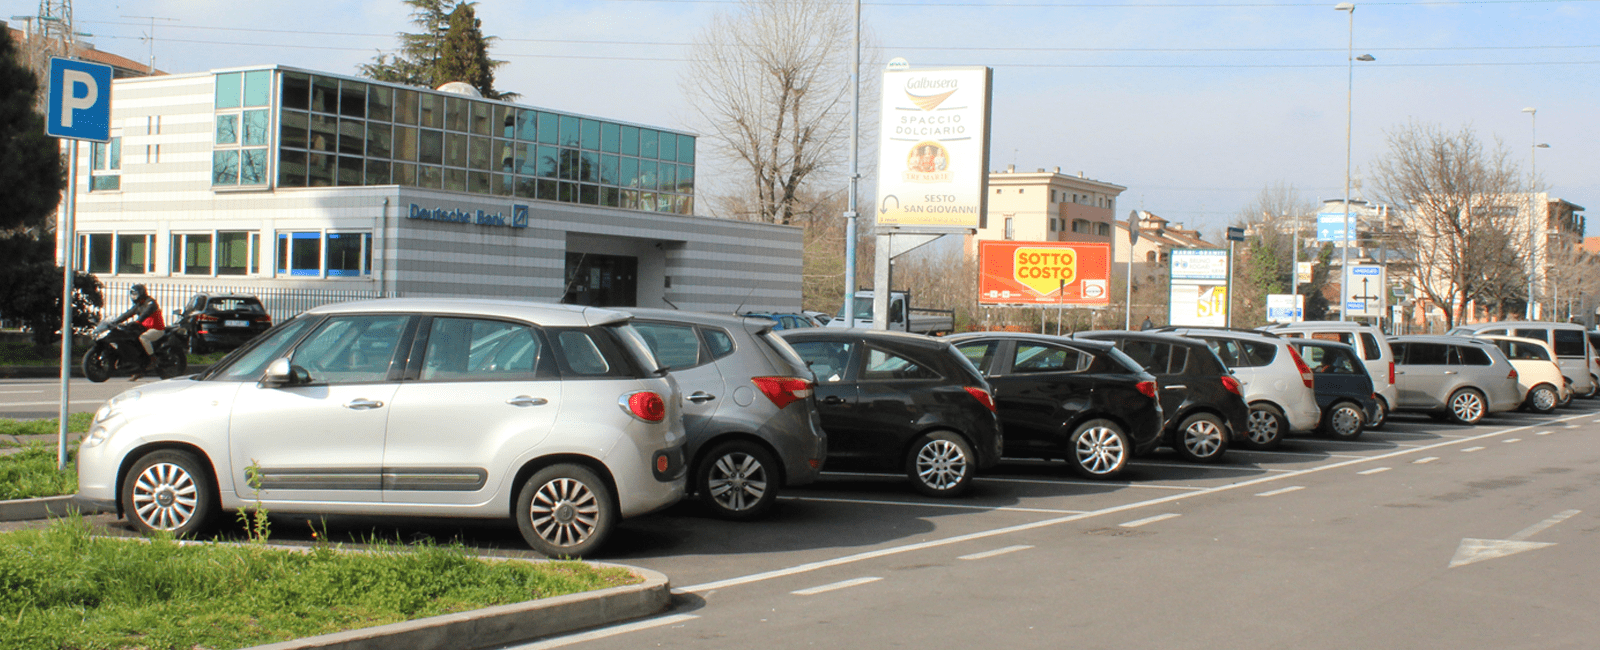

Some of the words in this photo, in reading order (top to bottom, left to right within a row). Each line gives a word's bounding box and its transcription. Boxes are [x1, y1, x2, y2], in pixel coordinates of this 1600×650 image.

[907, 77, 958, 89] Galbusera
[61, 69, 98, 127] P
[901, 114, 961, 124] SPACCIO
[896, 125, 965, 135] DOLCIARIO
[924, 194, 956, 203] SESTO
[409, 203, 471, 223] Deutsche
[475, 209, 505, 226] Bank
[904, 205, 924, 213] SAN
[926, 205, 977, 214] GIOVANNI
[1018, 252, 1073, 265] SOTTO
[1018, 266, 1073, 279] COSTO
